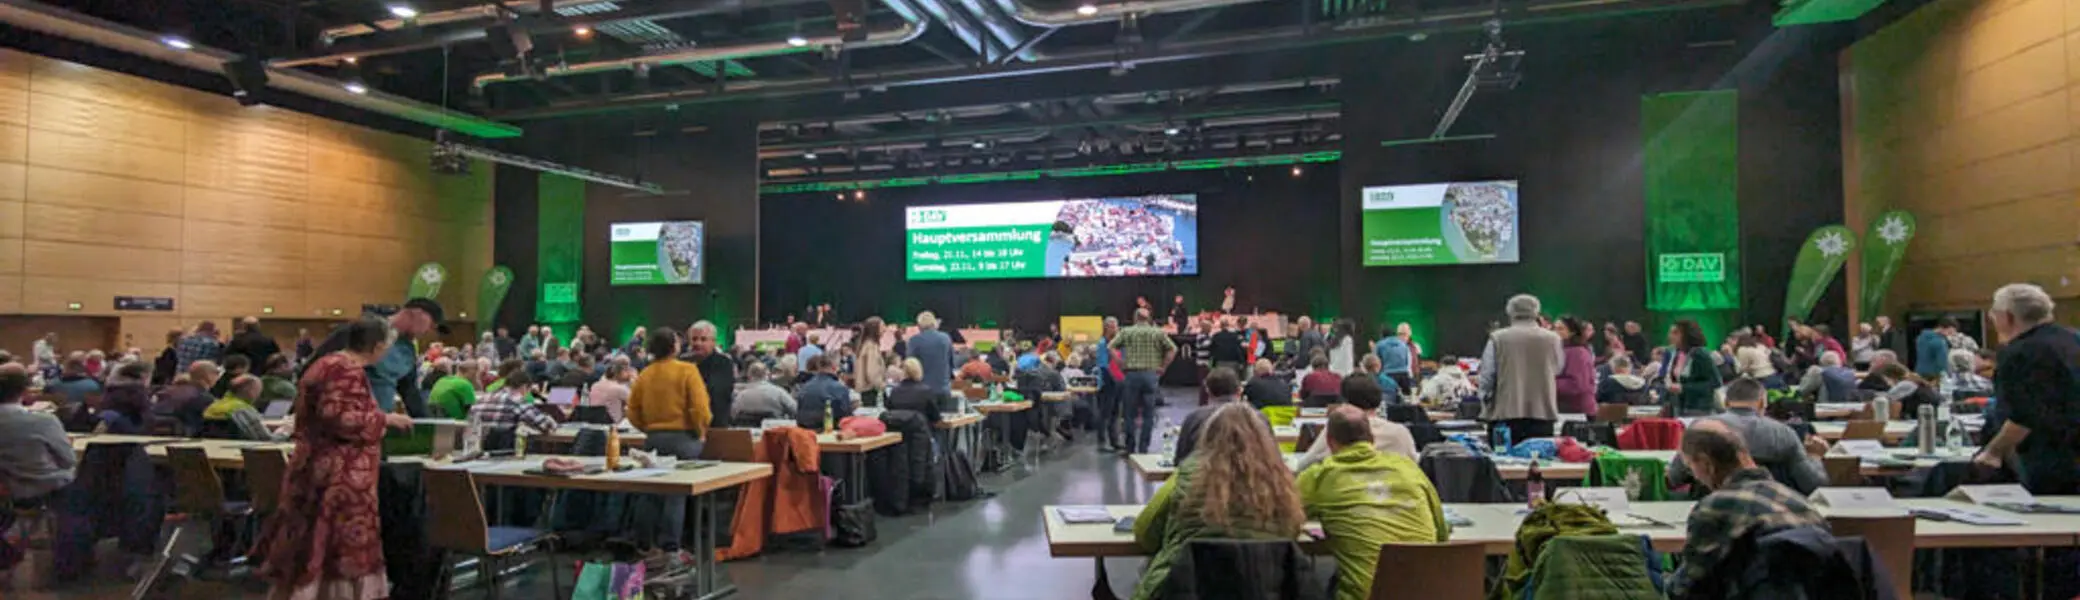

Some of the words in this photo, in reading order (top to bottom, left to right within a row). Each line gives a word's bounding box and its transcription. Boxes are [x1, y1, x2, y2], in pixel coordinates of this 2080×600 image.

[912, 228, 1041, 247] Hauptversammlung
[1009, 248, 1024, 257] Uhr
[1011, 260, 1026, 269] Uhr
[1683, 258, 1718, 270] DAV
